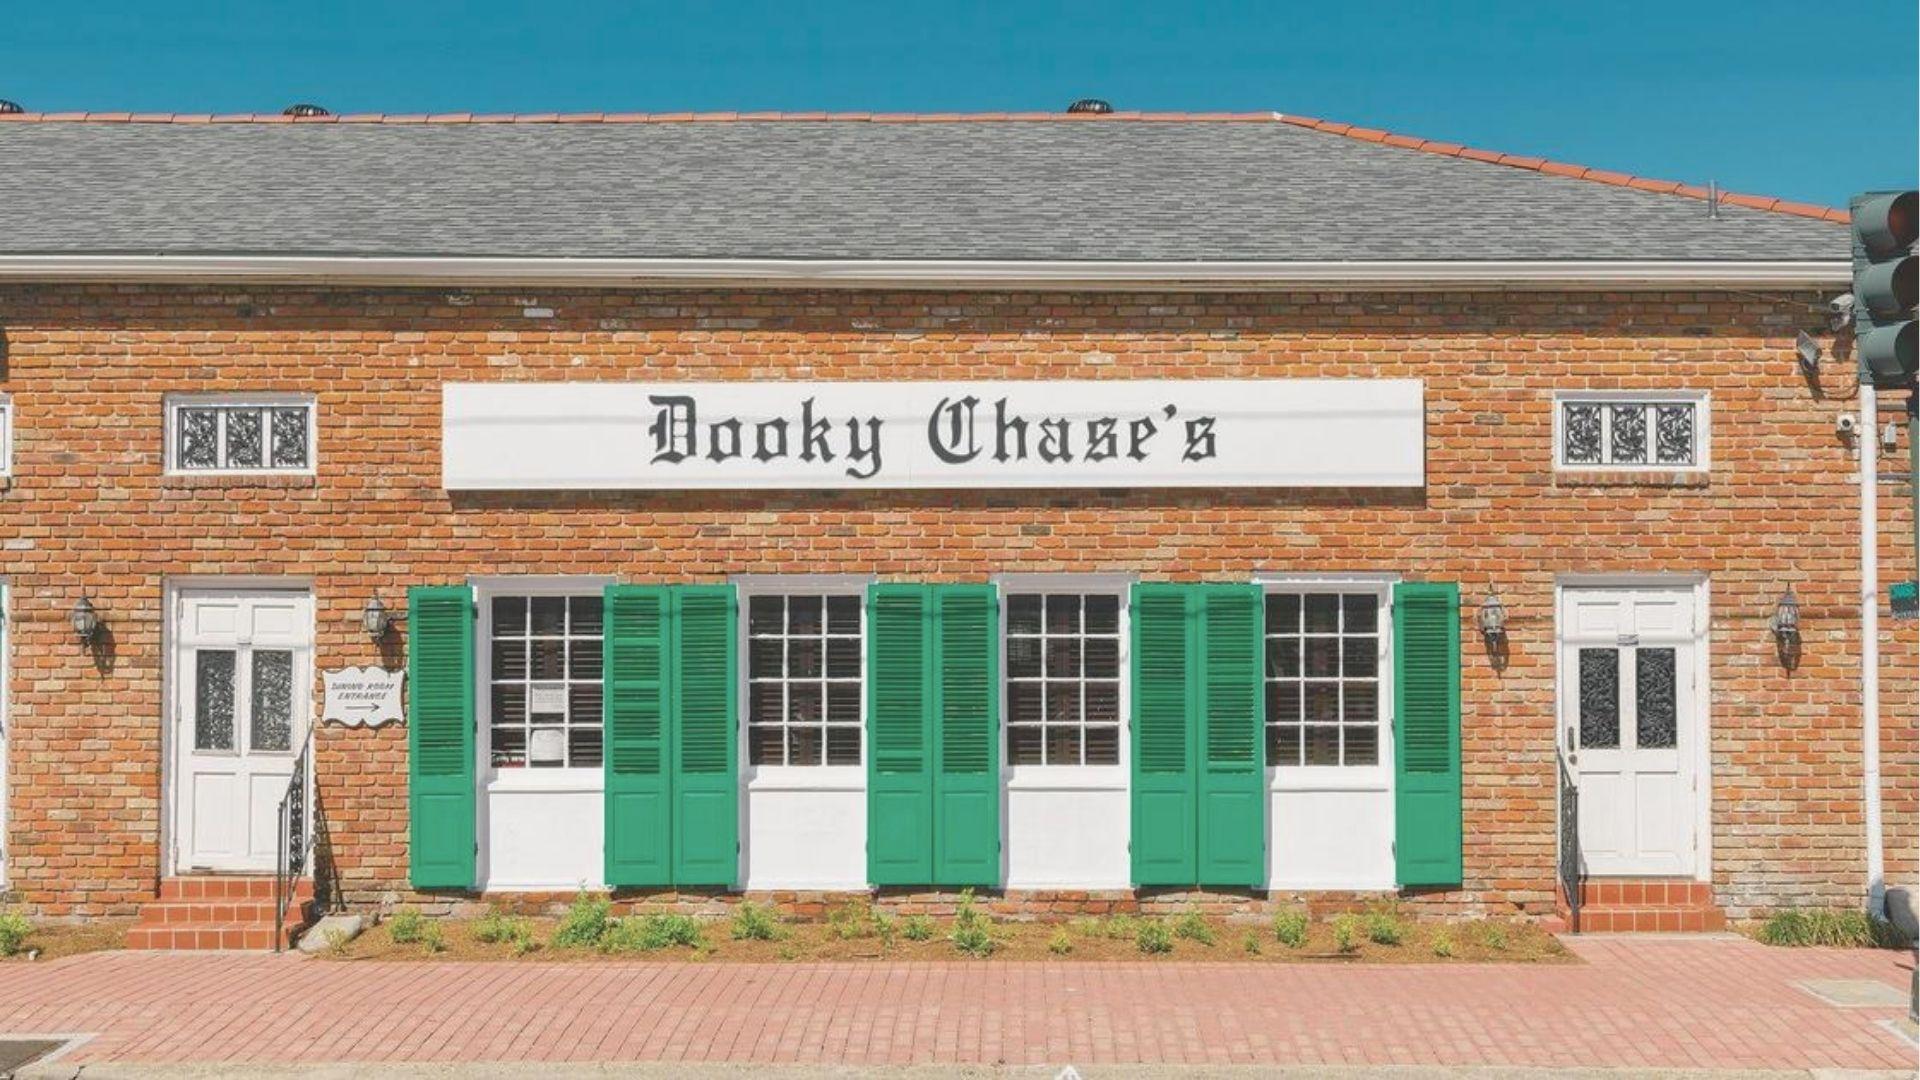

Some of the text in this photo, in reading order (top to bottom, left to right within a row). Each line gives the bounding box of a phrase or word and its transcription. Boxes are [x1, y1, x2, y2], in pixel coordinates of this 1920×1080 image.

[648, 395, 1217, 479] Dooky Chase's
[366, 682, 395, 690] ROOM
[337, 692, 388, 700] ENTRANCE
